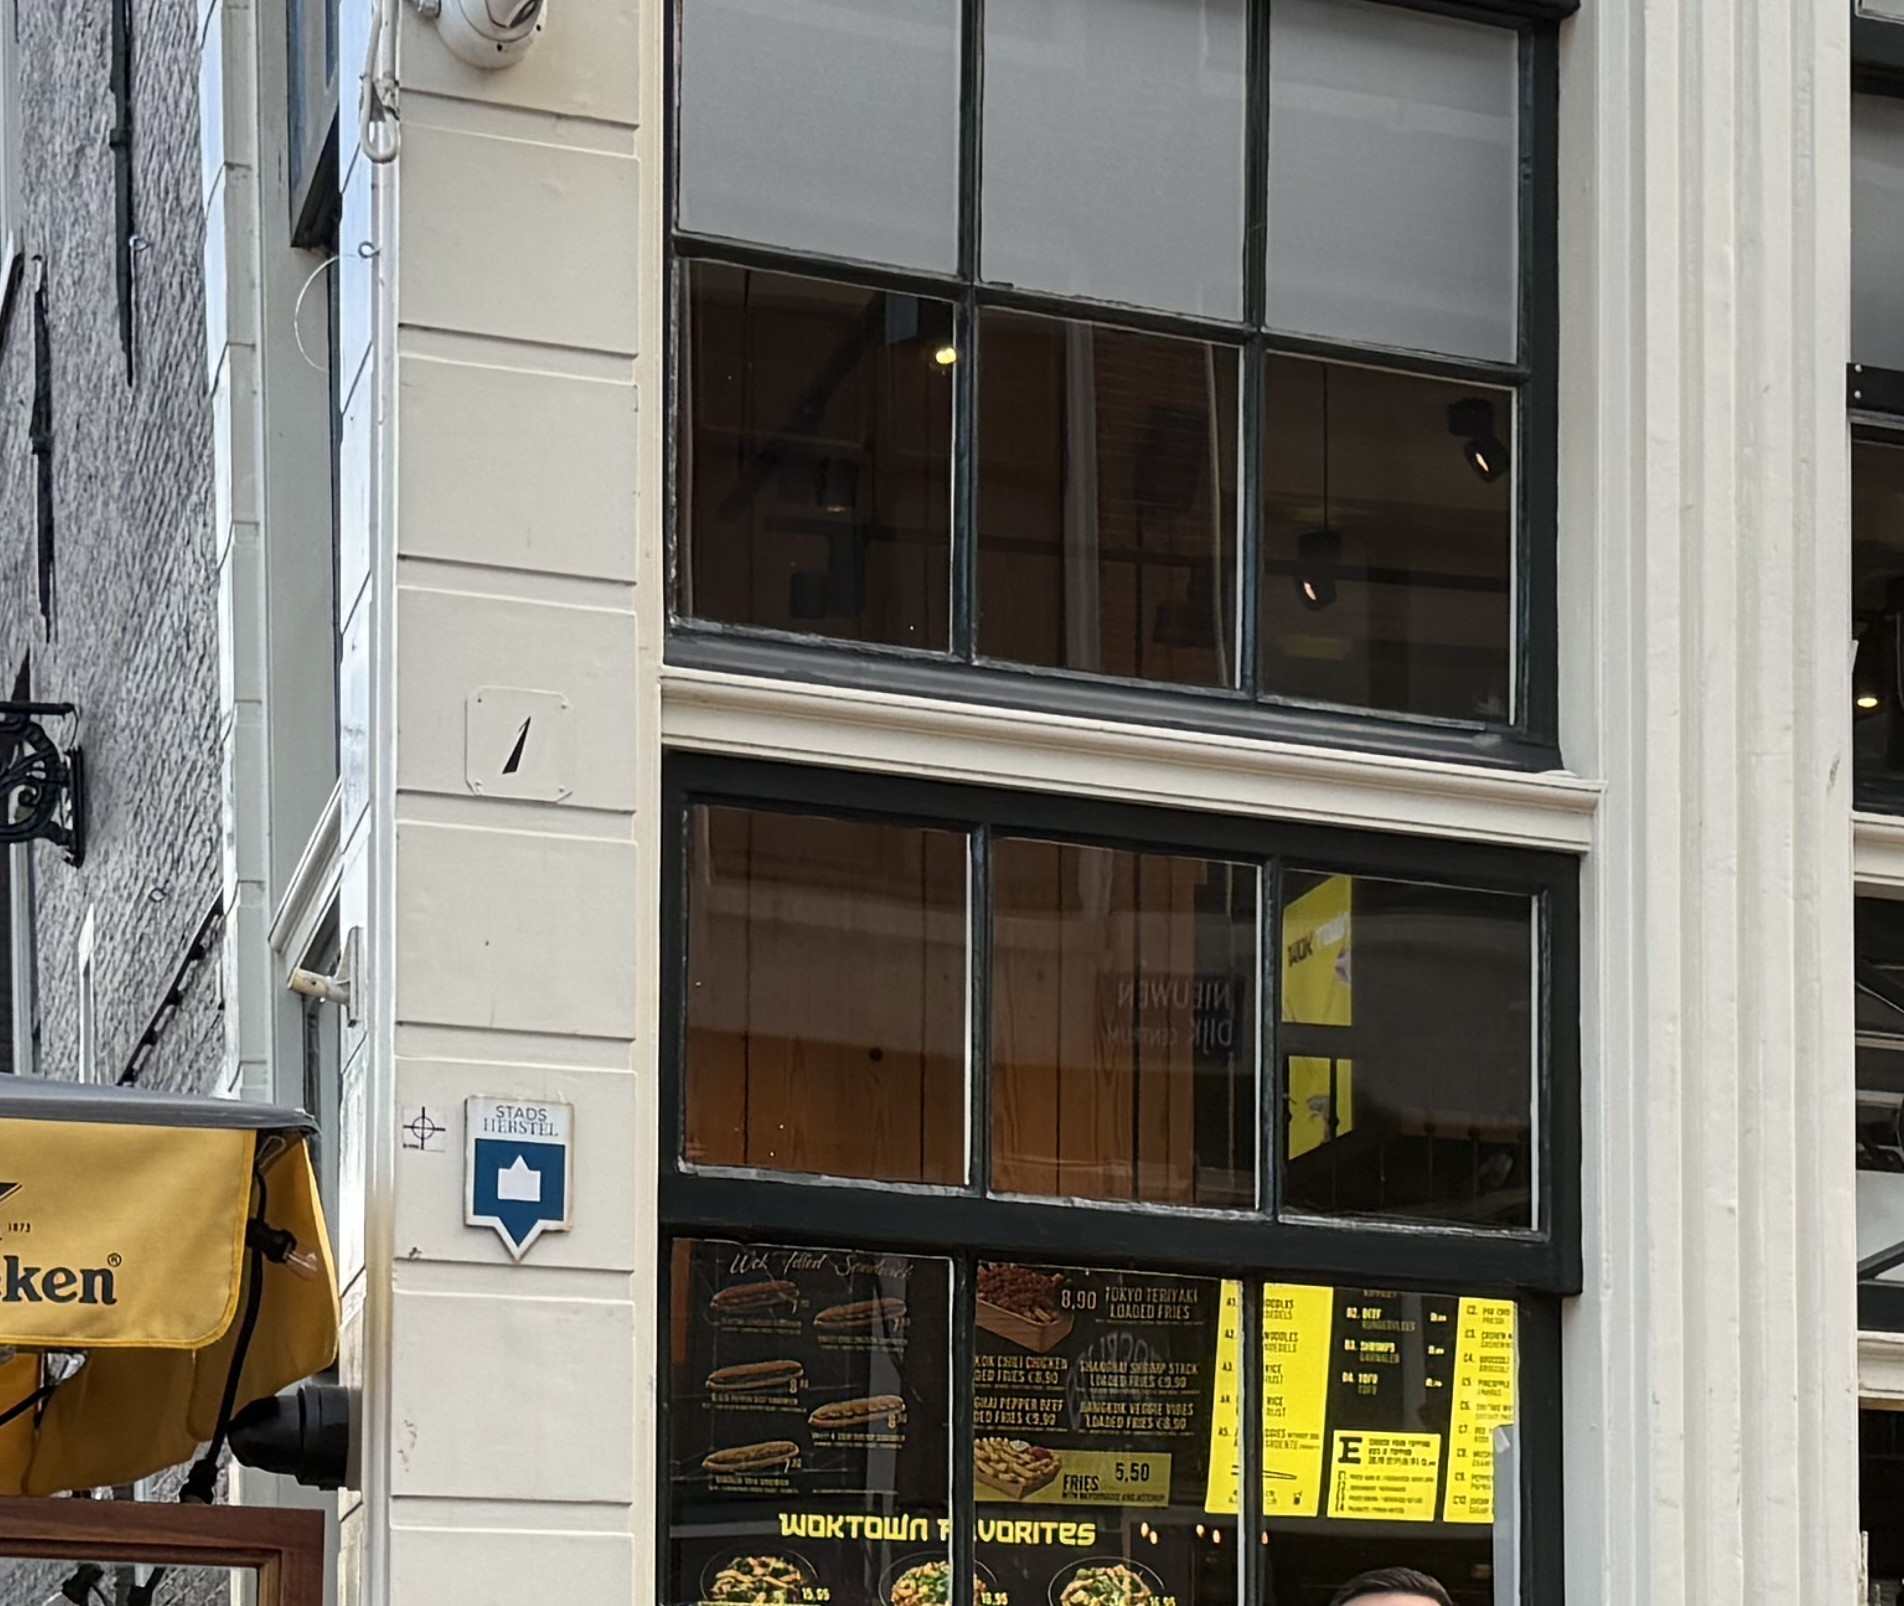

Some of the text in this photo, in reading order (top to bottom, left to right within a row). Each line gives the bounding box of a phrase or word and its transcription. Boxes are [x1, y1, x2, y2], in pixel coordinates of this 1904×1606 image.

[496, 1105, 547, 1121] STADS
[1105, 1286, 1197, 1302] TOKYO TERIYAKI
[1111, 1305, 1190, 1319] LOADED FRIES
[1026, 1357, 1067, 1370] CHICKEN
[1338, 1437, 1362, 1464] E
[1063, 1475, 1099, 1491] FRIES
[778, 1512, 1096, 1546] WOKTOWN FVORITES
